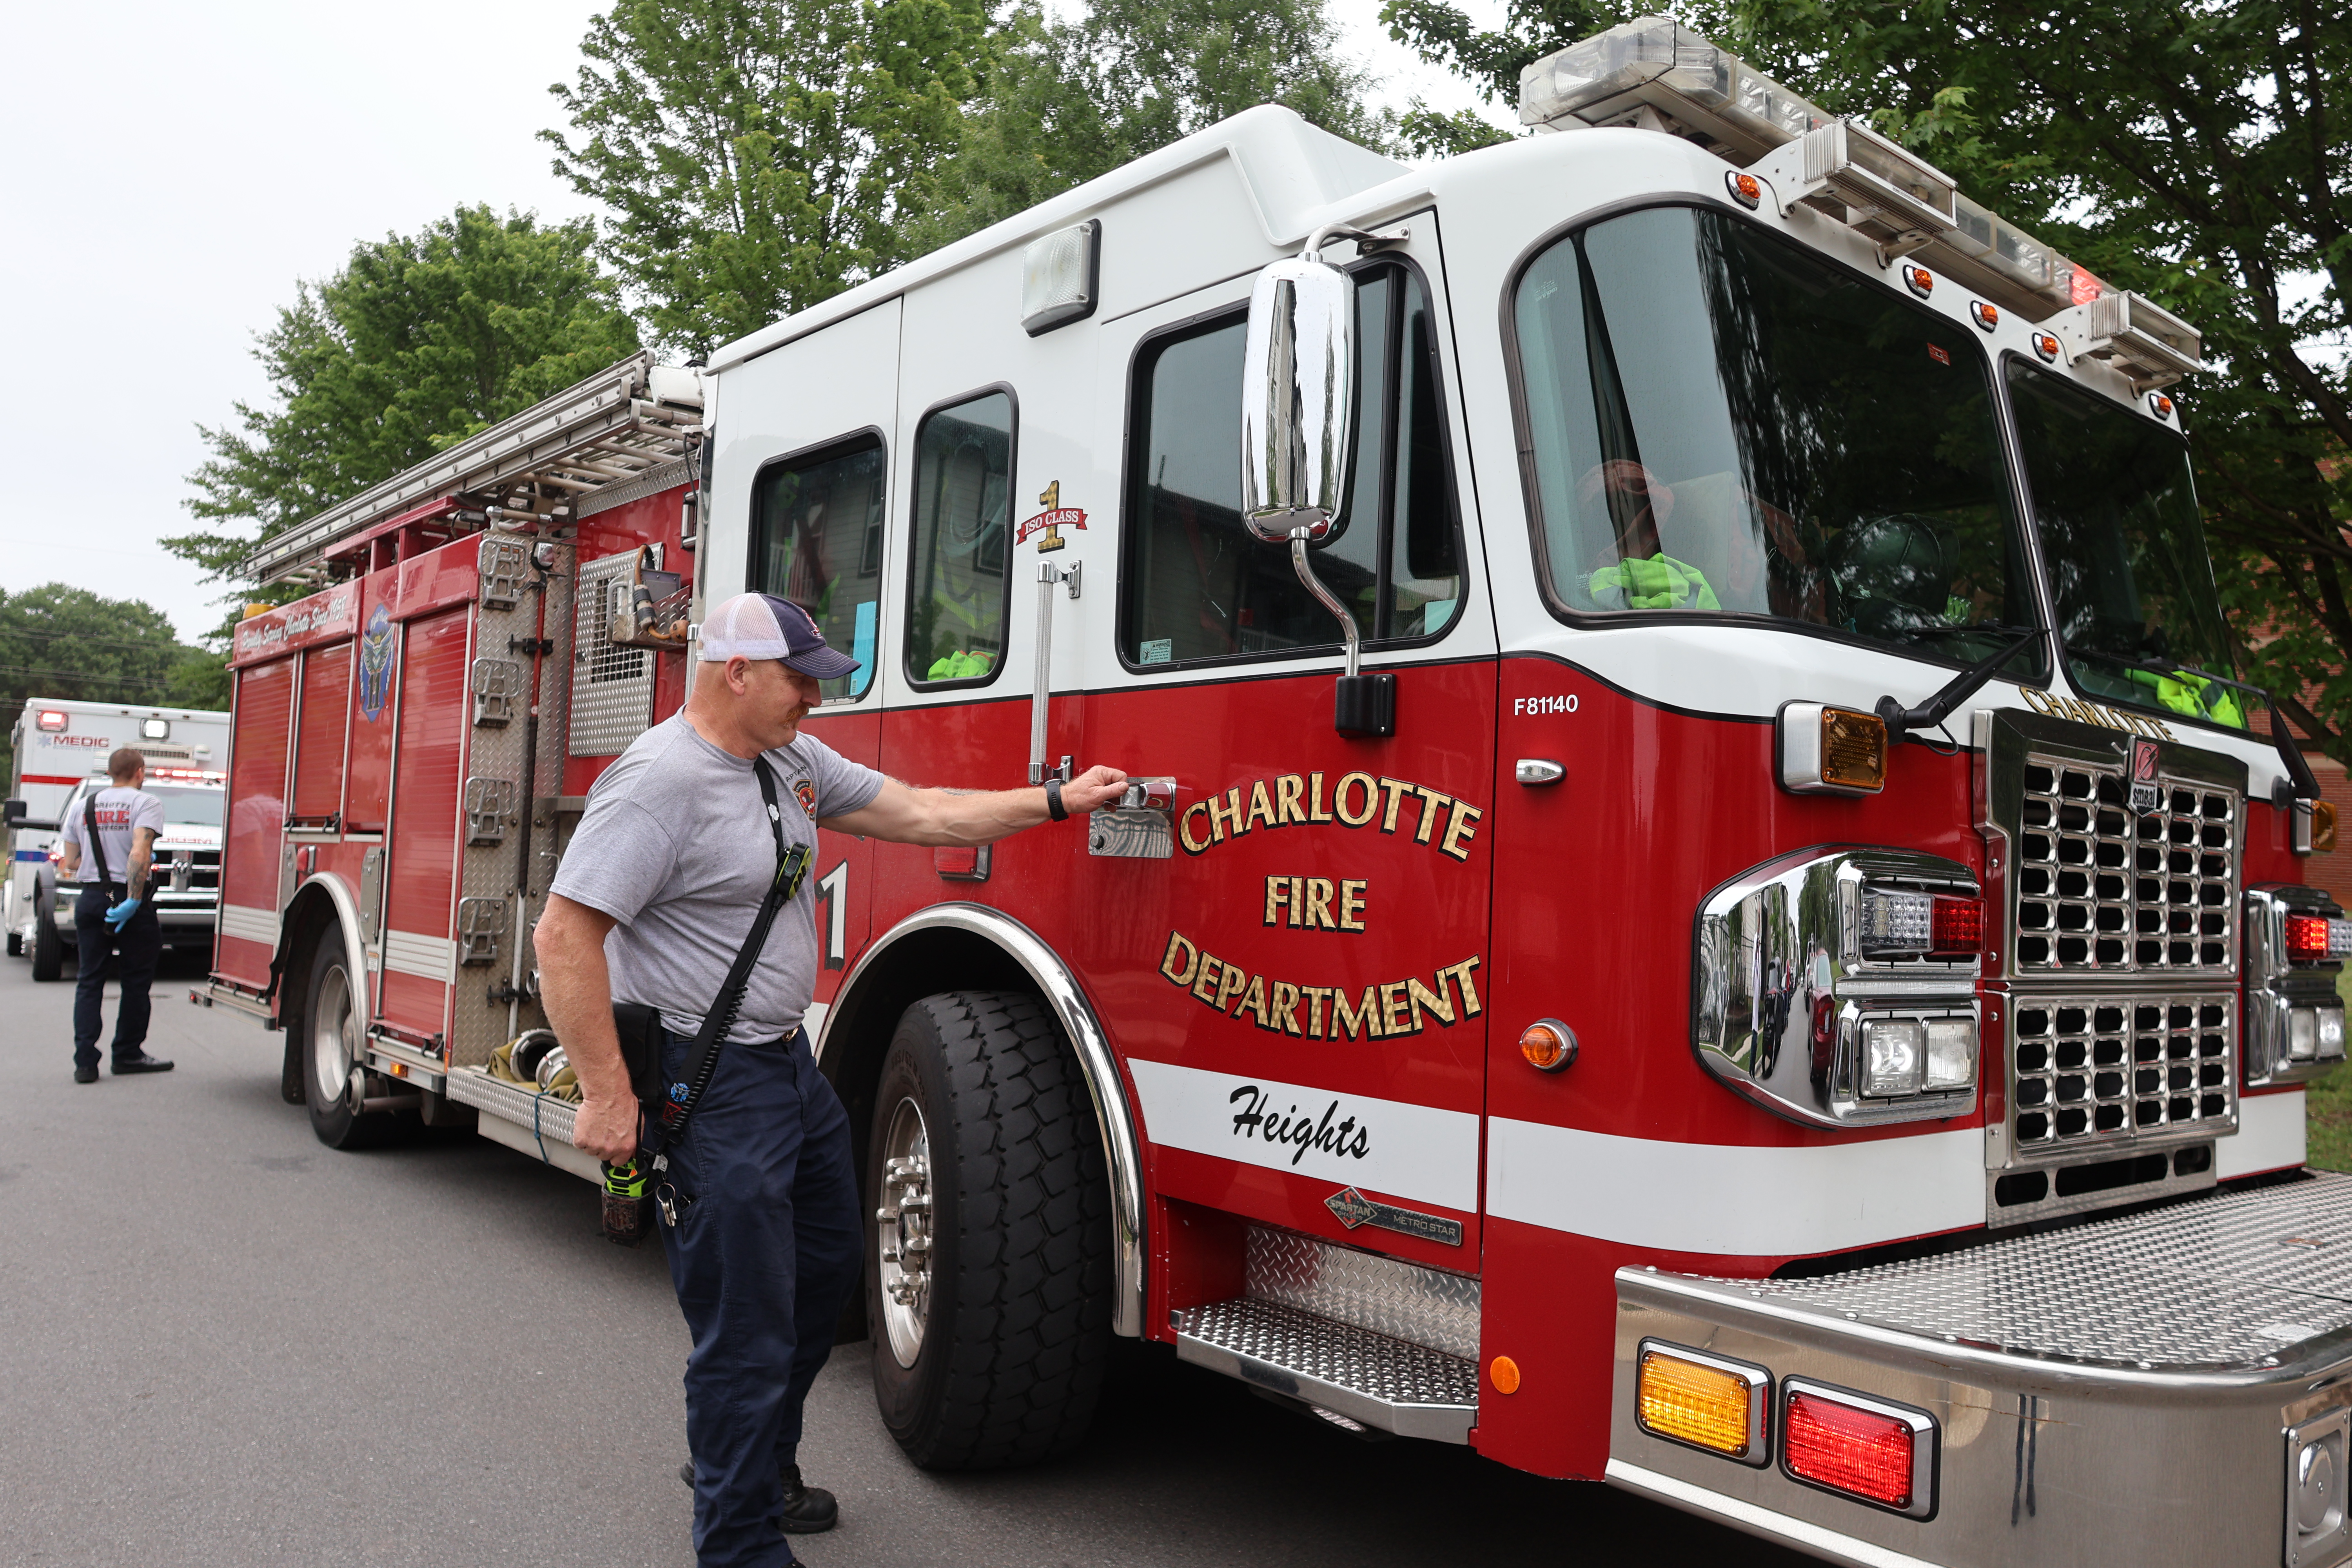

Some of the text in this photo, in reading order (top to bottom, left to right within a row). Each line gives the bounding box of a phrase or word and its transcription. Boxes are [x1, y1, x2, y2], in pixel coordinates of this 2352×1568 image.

[1024, 510, 1078, 535] ISO CLASS
[1038, 480, 1065, 554] 1
[263, 623, 283, 646] Serving
[283, 613, 310, 642] Charlotte
[310, 606, 328, 630] Since
[329, 594, 347, 623] 1958
[1515, 695, 1578, 715] F81140
[2019, 686, 2180, 744] CHARLOTTE
[54, 736, 109, 748] MEDIC
[83, 811, 130, 825] IRE
[1179, 771, 1483, 862] CHARLOTTE
[1263, 875, 1368, 933] FIRE
[1158, 930, 1483, 1042] DEPARTMENT
[1229, 1085, 1370, 1165] Heights
[1329, 1199, 1370, 1217] SPARTAN
[1338, 1210, 1363, 1221] CHASSIS
[1393, 1214, 1455, 1237] METRO STAR
